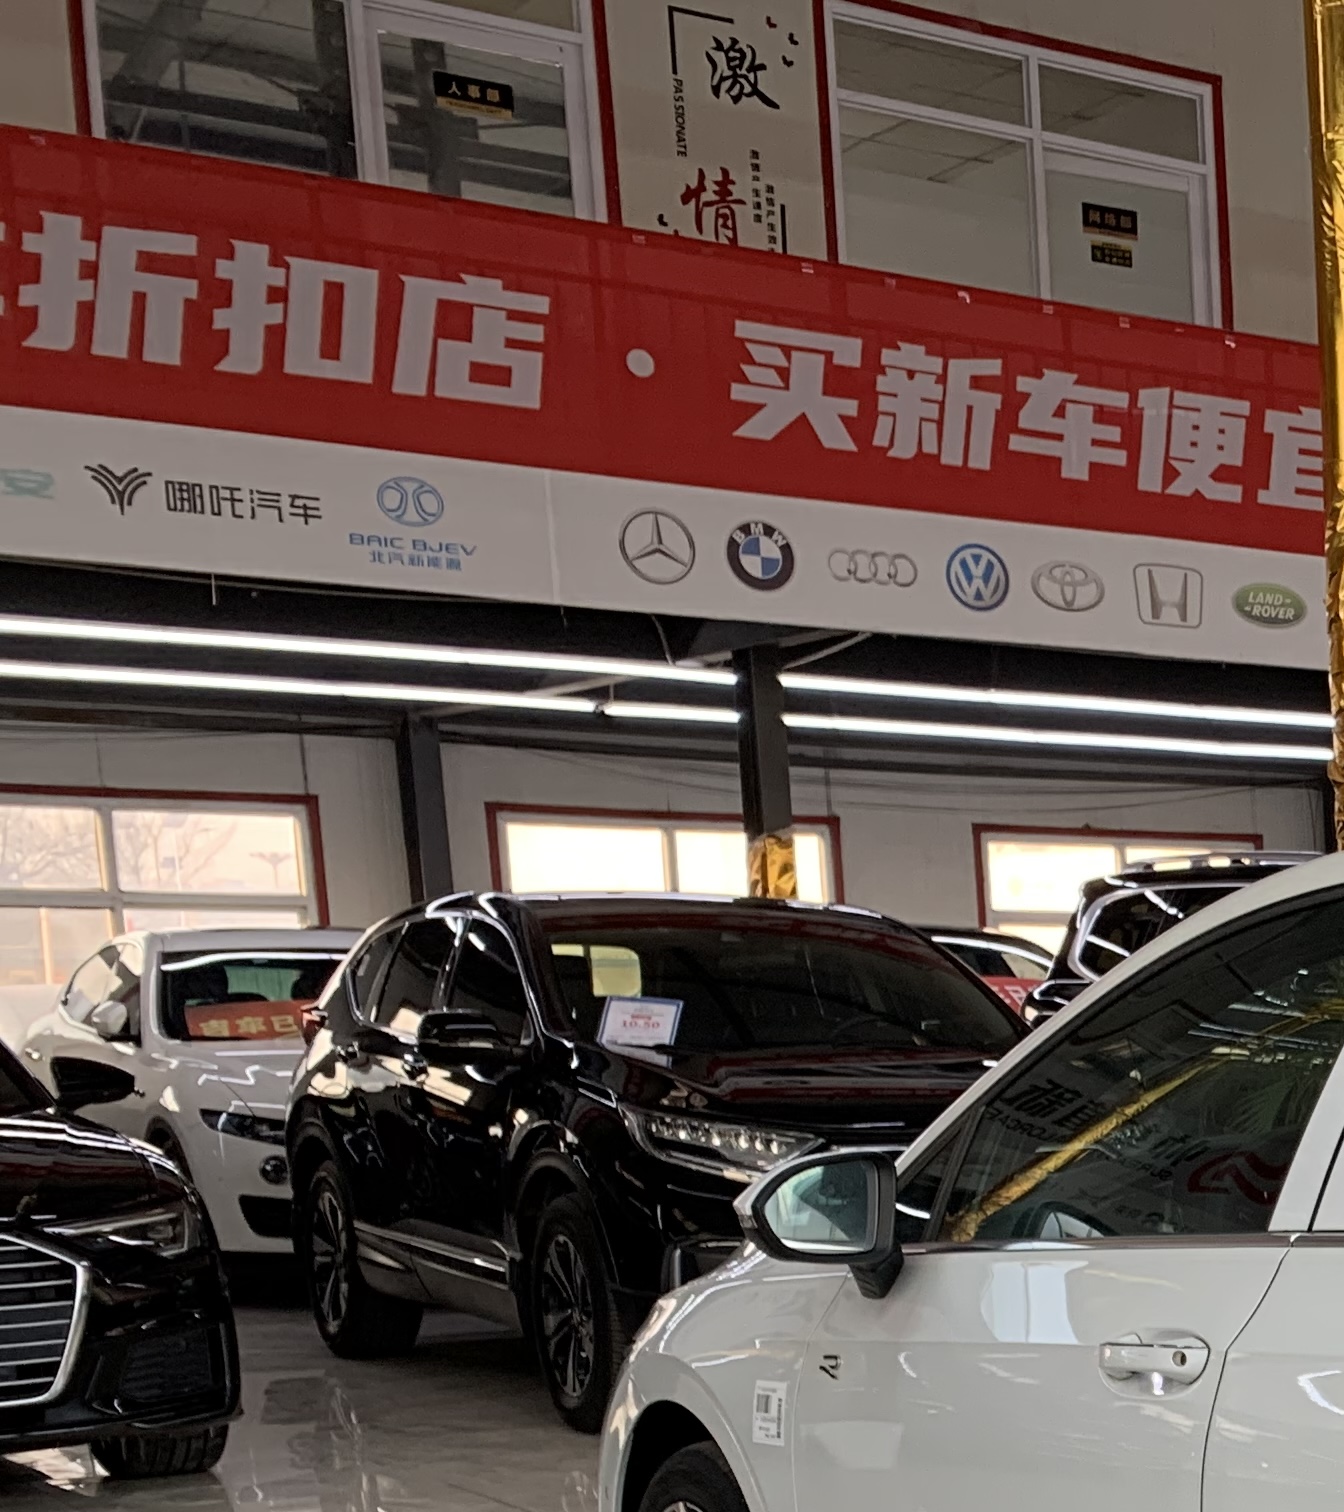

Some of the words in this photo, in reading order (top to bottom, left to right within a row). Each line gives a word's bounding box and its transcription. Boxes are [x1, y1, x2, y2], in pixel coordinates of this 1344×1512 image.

[672, 77, 687, 157] PASSIONATE
[0, 211, 550, 410] 折扣店
[164, 479, 323, 526] 哪吒汽车
[348, 532, 405, 551] BAIC
[411, 538, 479, 558] BJEV
[1248, 591, 1284, 606] LAND
[1251, 604, 1296, 620] ROVER
